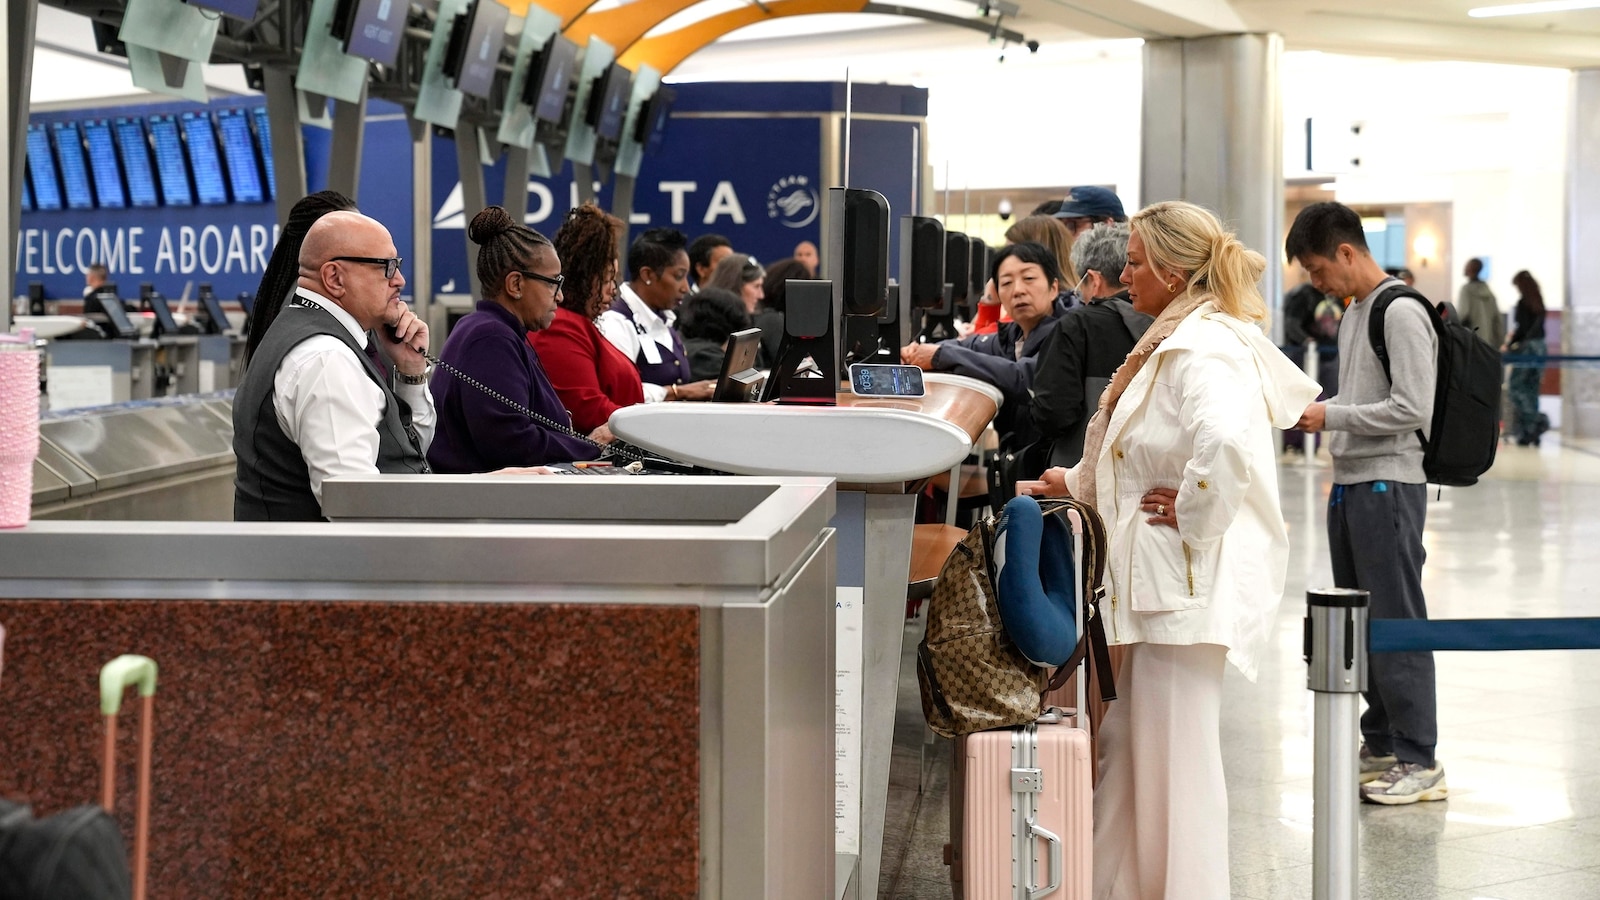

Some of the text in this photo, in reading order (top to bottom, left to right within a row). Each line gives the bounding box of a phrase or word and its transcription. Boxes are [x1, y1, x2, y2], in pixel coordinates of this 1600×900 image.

[522, 181, 746, 225] DTA
[15, 226, 144, 275] ELCOME
[301, 298, 324, 310] ELTA
[860, 369, 871, 391] 10:39
